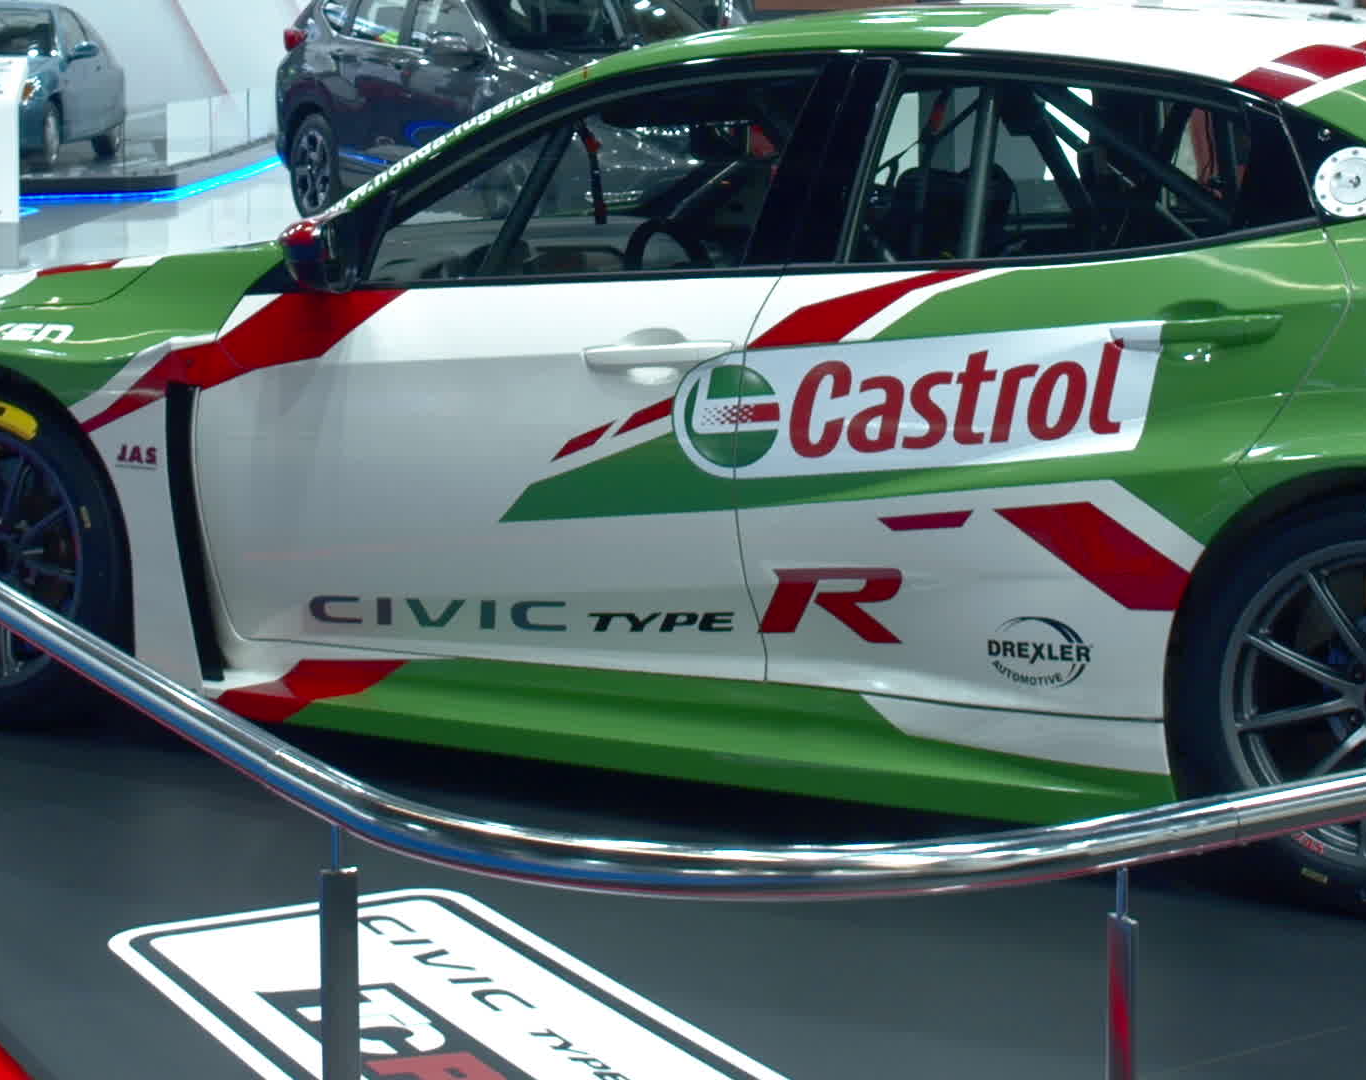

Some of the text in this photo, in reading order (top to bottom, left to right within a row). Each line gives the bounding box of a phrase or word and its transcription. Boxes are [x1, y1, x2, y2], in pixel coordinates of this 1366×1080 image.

[789, 336, 1125, 459] Castrol
[117, 443, 157, 465] JAS
[308, 567, 903, 644] CIVIC TYPE R
[987, 639, 1091, 664] DREXLER
[992, 660, 1063, 686] AUTOMOTIVE
[359, 915, 537, 1012] CIVIC
